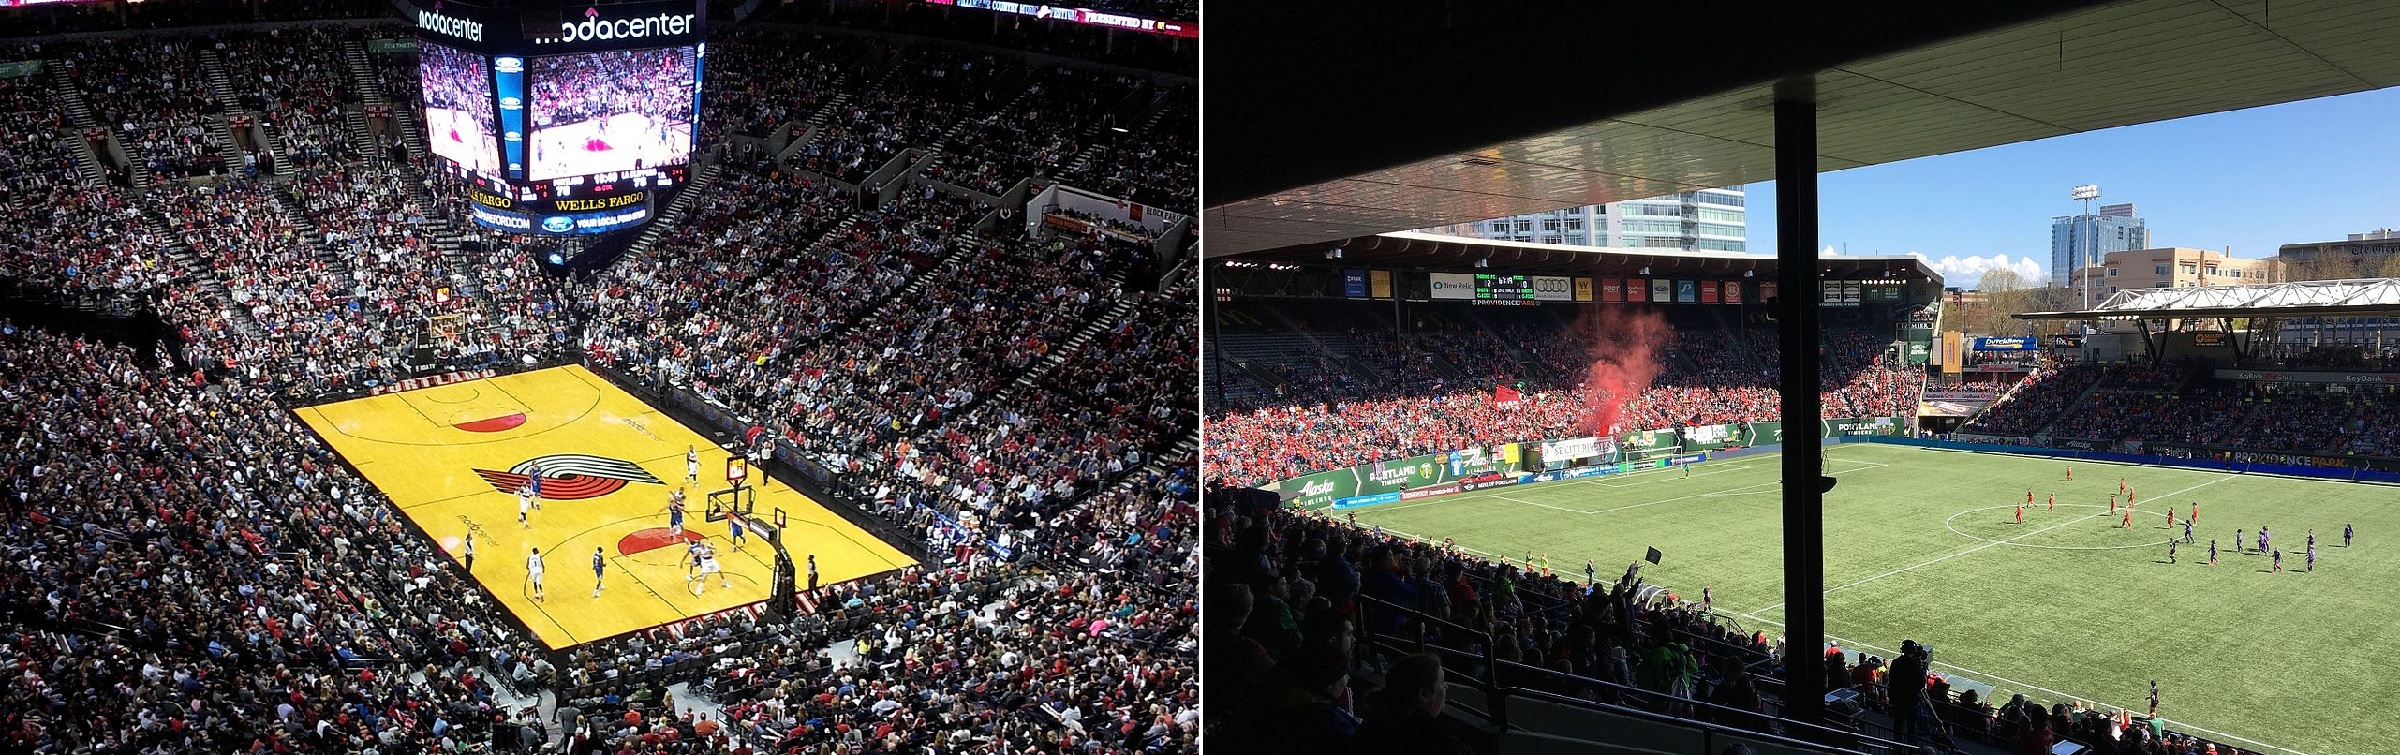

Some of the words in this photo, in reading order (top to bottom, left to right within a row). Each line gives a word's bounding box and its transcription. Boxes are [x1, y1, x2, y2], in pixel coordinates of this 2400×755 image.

[1085, 12, 1141, 27] PRESENTED
[1141, 19, 1155, 30] BY
[479, 193, 511, 208] FARGO
[555, 200, 606, 212] WELLS
[609, 191, 644, 208] FARGO
[1146, 206, 1163, 218] BLOCK
[2055, 337, 2067, 346] fix
[1980, 363, 2015, 372] Budweiser
[370, 368, 497, 396] PORTLAND
[2346, 375, 2382, 383] KeyBank
[1564, 443, 1580, 454] CITY
[1298, 479, 1335, 497] Alaska
